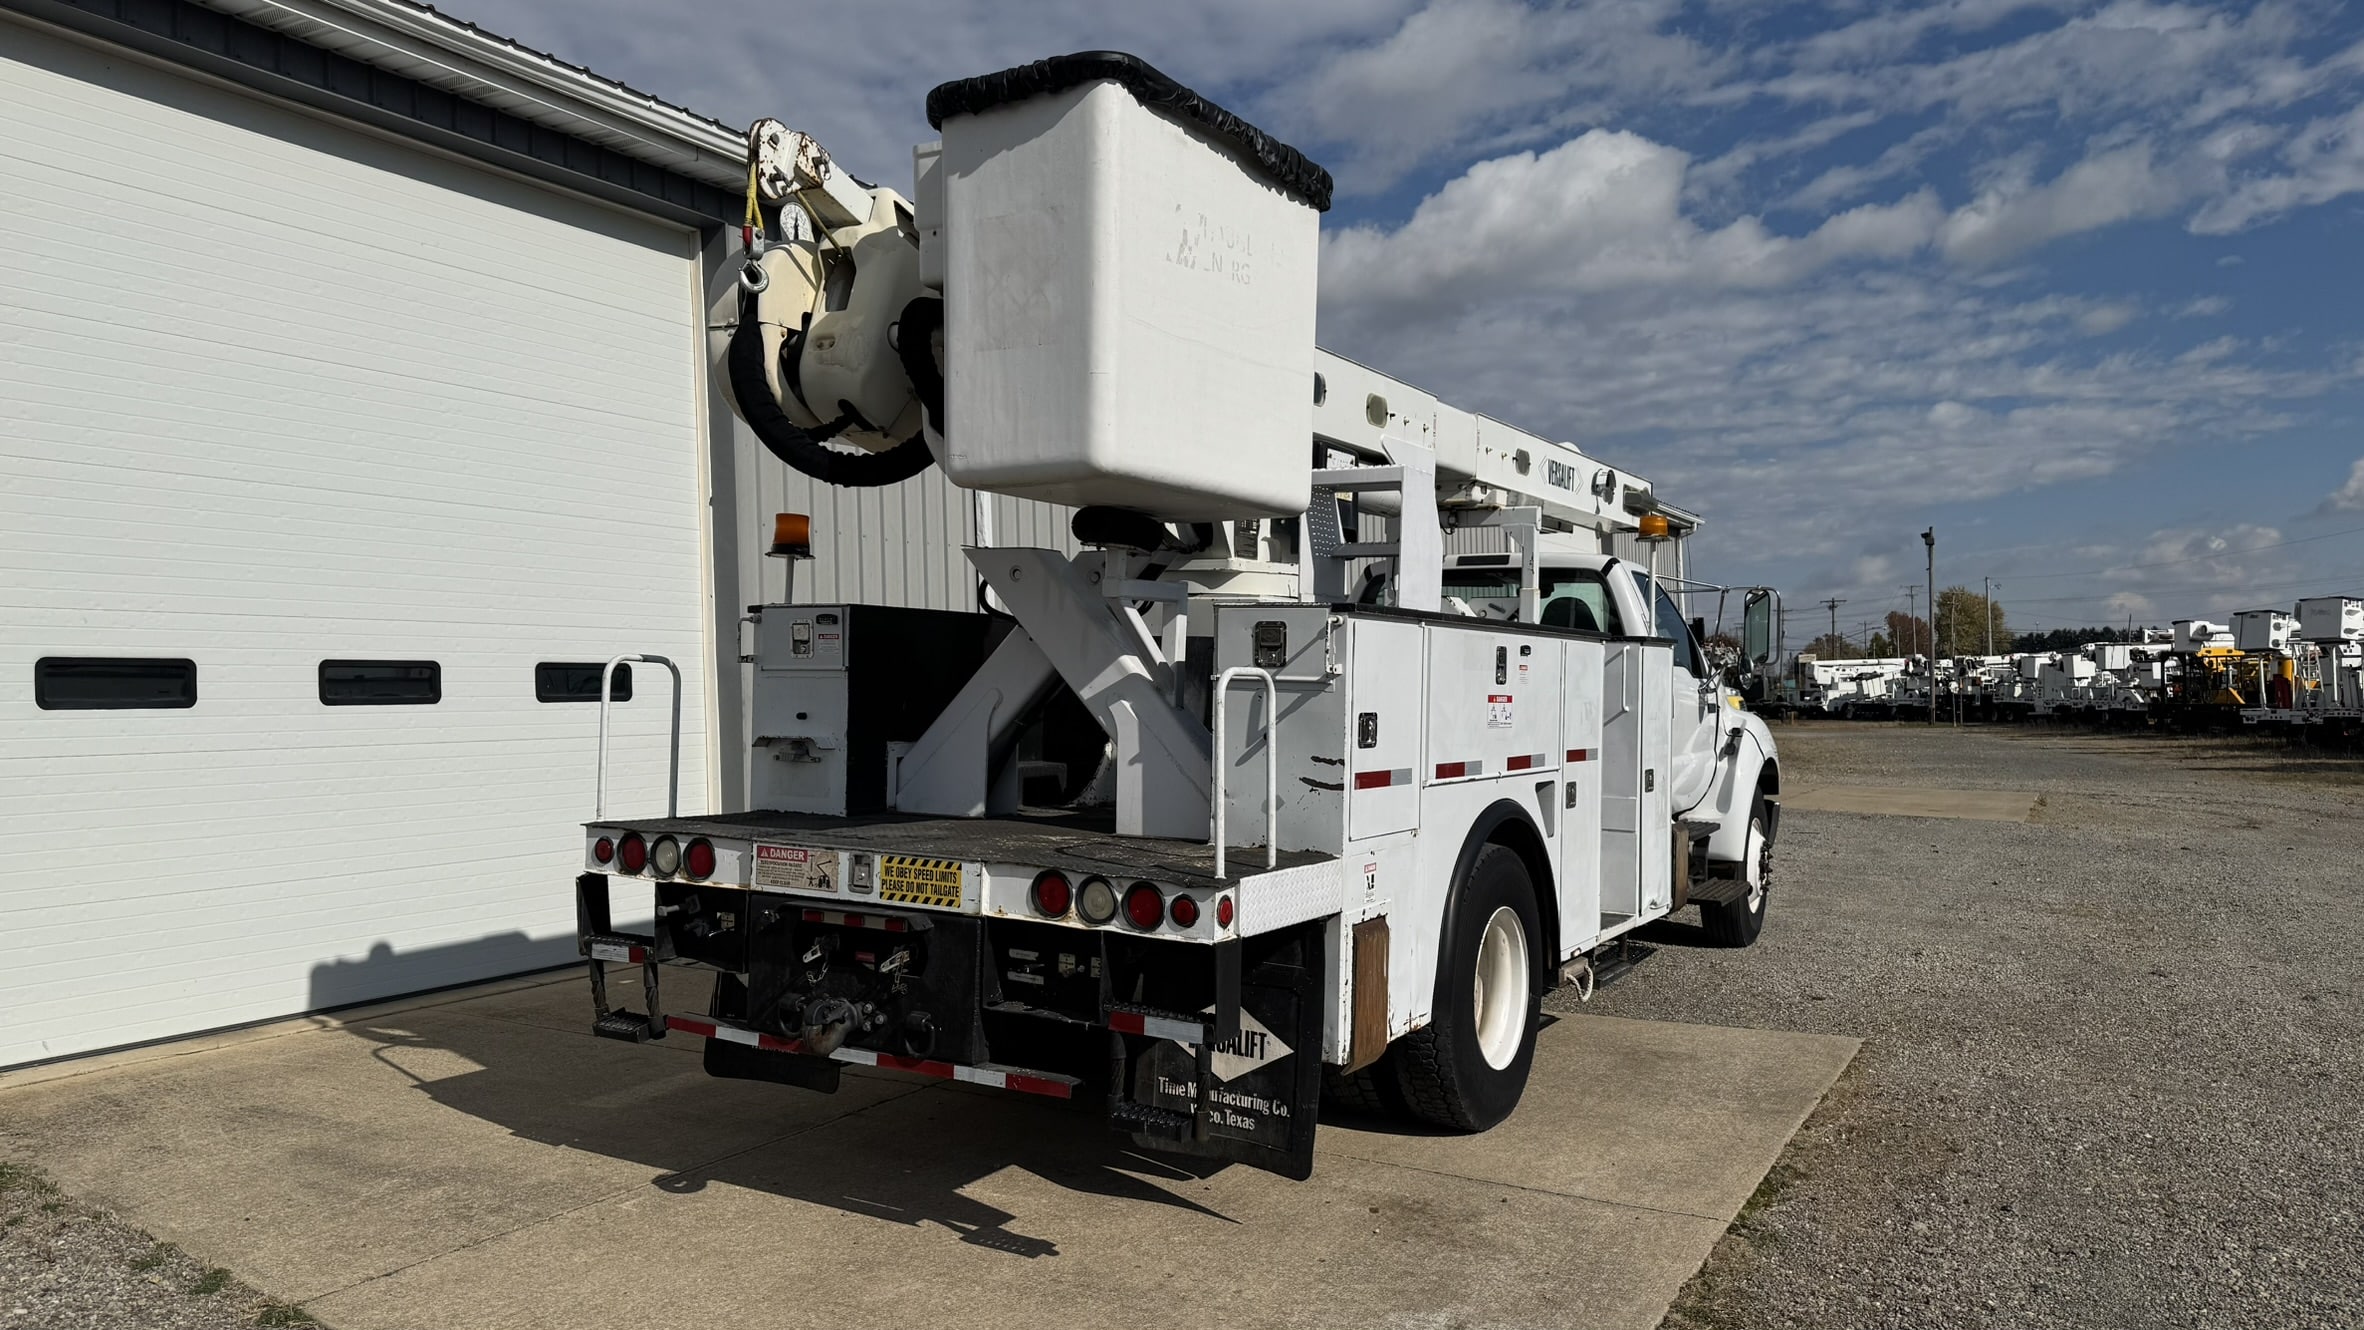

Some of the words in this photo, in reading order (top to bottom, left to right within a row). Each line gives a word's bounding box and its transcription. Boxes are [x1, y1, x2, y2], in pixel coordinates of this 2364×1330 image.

[1547, 458, 1575, 493] VERSALIFT
[770, 848, 805, 861] DANGER
[884, 865, 894, 878] WE
[895, 866, 912, 879] OBEY
[914, 868, 934, 881] SPEED
[935, 870, 957, 884] LIMITS
[881, 879, 904, 892] PLEASE
[906, 881, 914, 893] DO
[916, 882, 928, 894] NOT
[930, 883, 960, 898] TAILGATE
[1158, 1076, 1185, 1097] Time
[1187, 1081, 1270, 1116] Mufacturing
[1272, 1099, 1291, 1118] Co.
[1224, 1108, 1255, 1131] Texas
